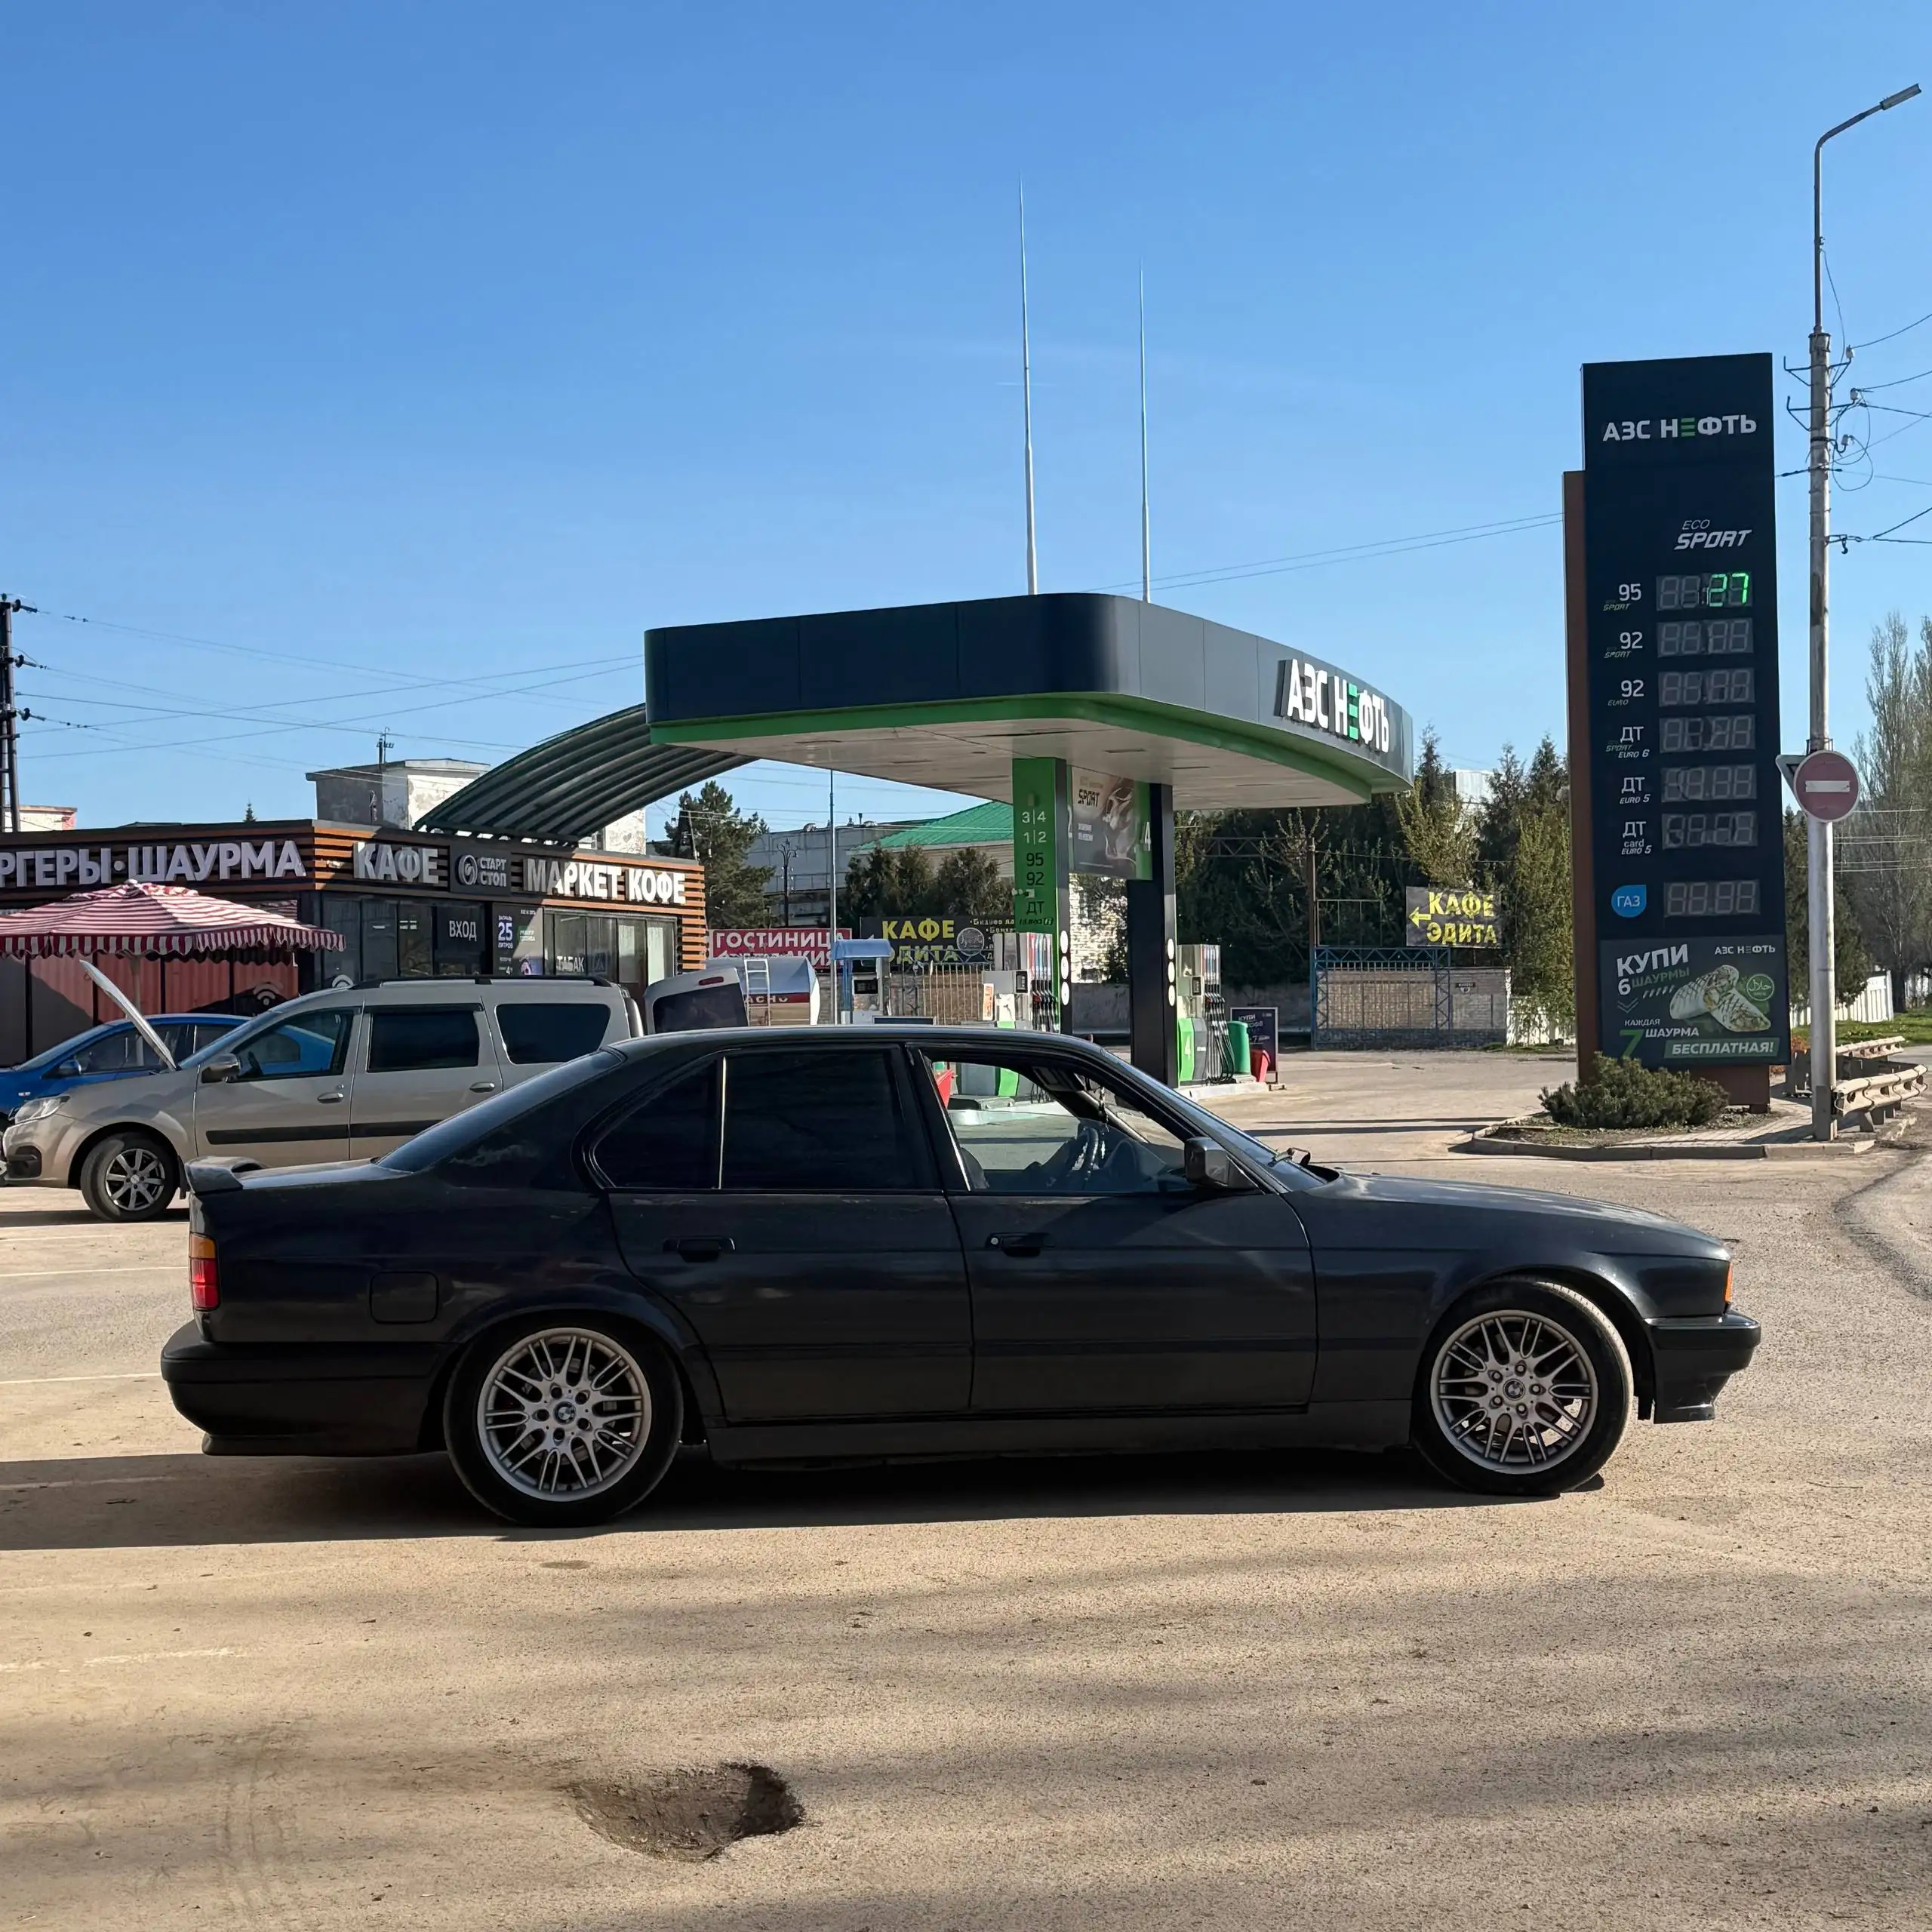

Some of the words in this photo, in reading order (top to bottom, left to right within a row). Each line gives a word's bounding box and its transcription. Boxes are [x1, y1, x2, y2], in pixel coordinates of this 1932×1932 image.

[1602, 420, 1651, 441] АЗС
[1660, 414, 1757, 438] НЕФТЬ
[1682, 519, 1710, 530] ECO
[1674, 530, 1752, 550] SPORT
[1618, 583, 1641, 601] 95
[1603, 603, 1631, 611] SPORT
[1619, 632, 1643, 649] 92
[1604, 651, 1632, 659] SPORT
[1620, 680, 1644, 697] 92
[1286, 658, 1329, 729] АЗС
[1334, 675, 1389, 753] НЕФТЬ
[1620, 726, 1644, 743] ДТ
[1605, 744, 1632, 752] SPORT
[1642, 749, 1650, 758] 6
[1622, 777, 1645, 793] ДТ
[1620, 796, 1640, 804] EURO
[1643, 794, 1651, 803] 5
[1623, 821, 1647, 838] ДТ
[1624, 838, 1644, 848] card
[1644, 845, 1651, 854] 5
[128, 840, 306, 882] ШАУРМА
[353, 841, 438, 884] КАФЕ
[479, 857, 506, 871] СТАРТ
[1026, 852, 1044, 867] 95
[479, 871, 506, 888] СТОП
[523, 858, 622, 899] МАРКЕТ
[627, 867, 686, 905] КОФЕ
[1026, 872, 1044, 886] 92
[1026, 901, 1044, 915] ДТ
[1428, 890, 1495, 918] КАФЕ
[1617, 895, 1641, 907] ГАЗ
[449, 921, 477, 942] ВХОД
[498, 921, 513, 942] 25
[881, 918, 955, 941] КАФЕ
[1426, 921, 1498, 946] ЭДИТА
[1715, 946, 1734, 955] АЗС
[1737, 945, 1776, 954] НЕФТЬ
[1617, 943, 1688, 977] КУПИ
[1617, 979, 1632, 995] 6
[1632, 967, 1690, 988] ШАУРМЫ
[1619, 1029, 1644, 1057] 7
[1645, 1027, 1700, 1038] ШАУРМА
[1672, 1041, 1774, 1055] БЕСПЛАТНАЯ!
